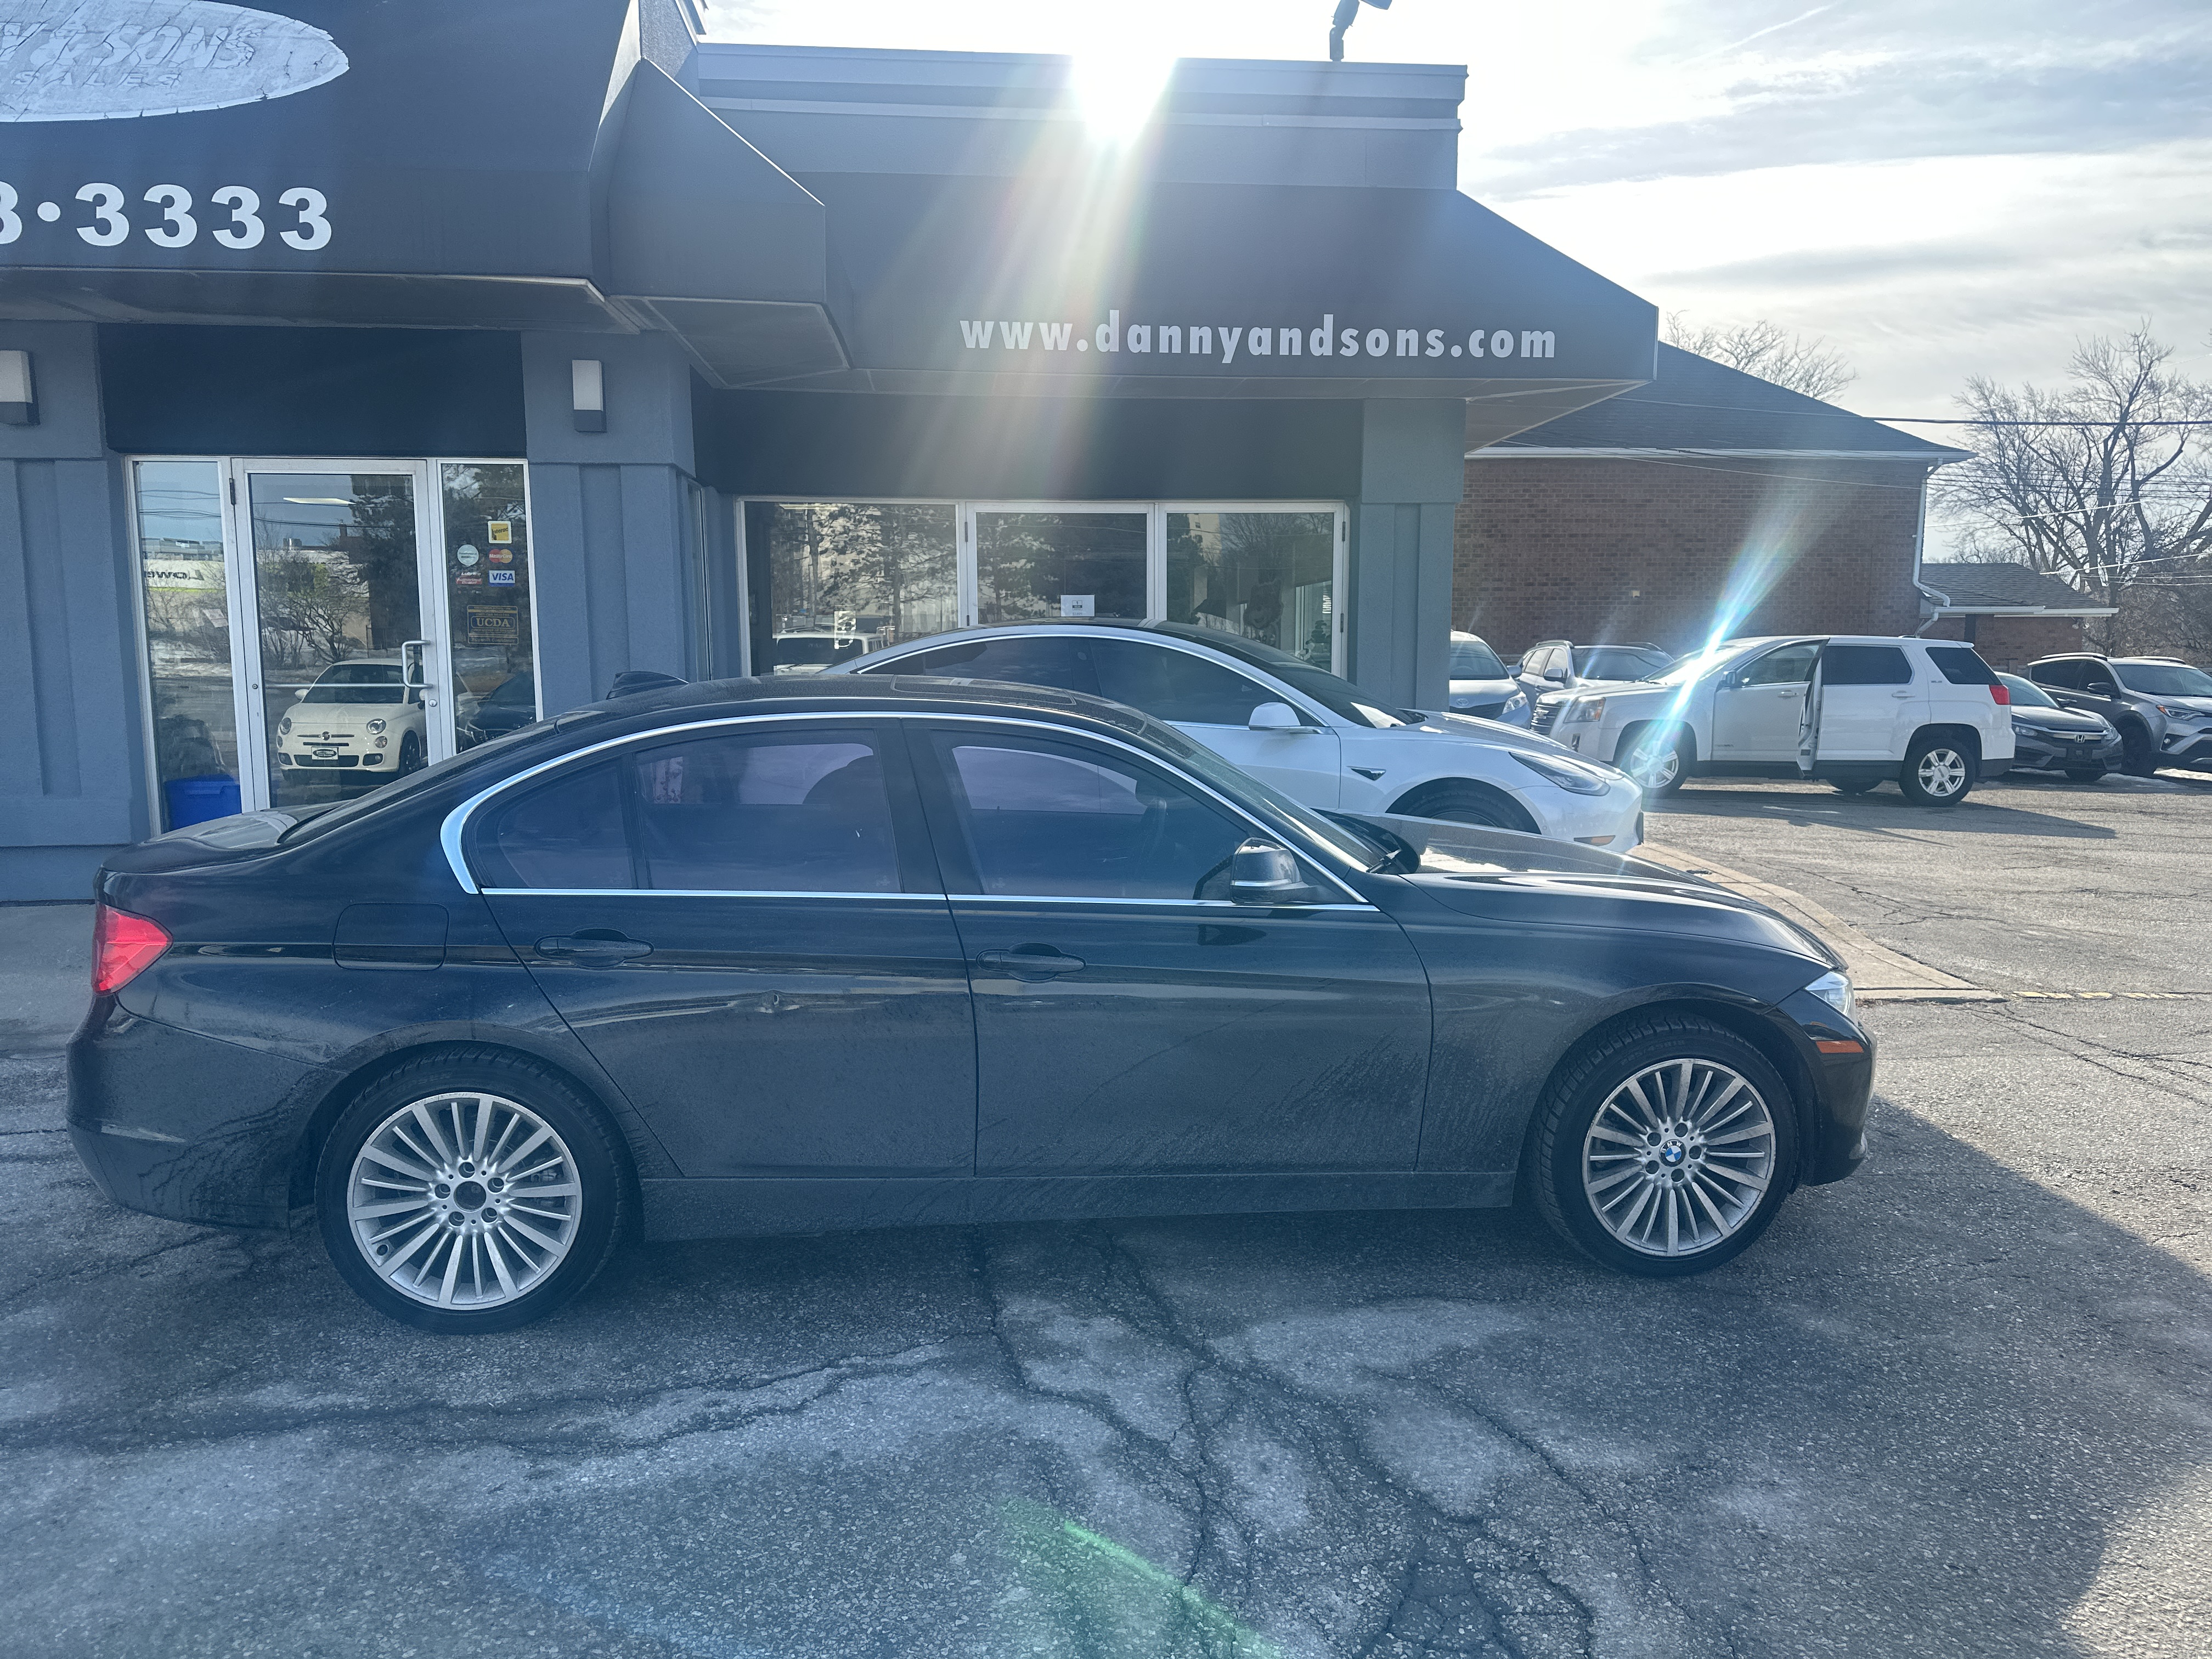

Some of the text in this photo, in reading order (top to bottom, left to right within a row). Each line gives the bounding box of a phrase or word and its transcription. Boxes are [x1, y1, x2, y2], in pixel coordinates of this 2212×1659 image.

[11, 71, 182, 88] SALES
[959, 309, 1556, 363] www.dannyandsons.com
[492, 573, 514, 581] VISA
[476, 618, 511, 627] UCDA
[1660, 1141, 1683, 1153] BMW
